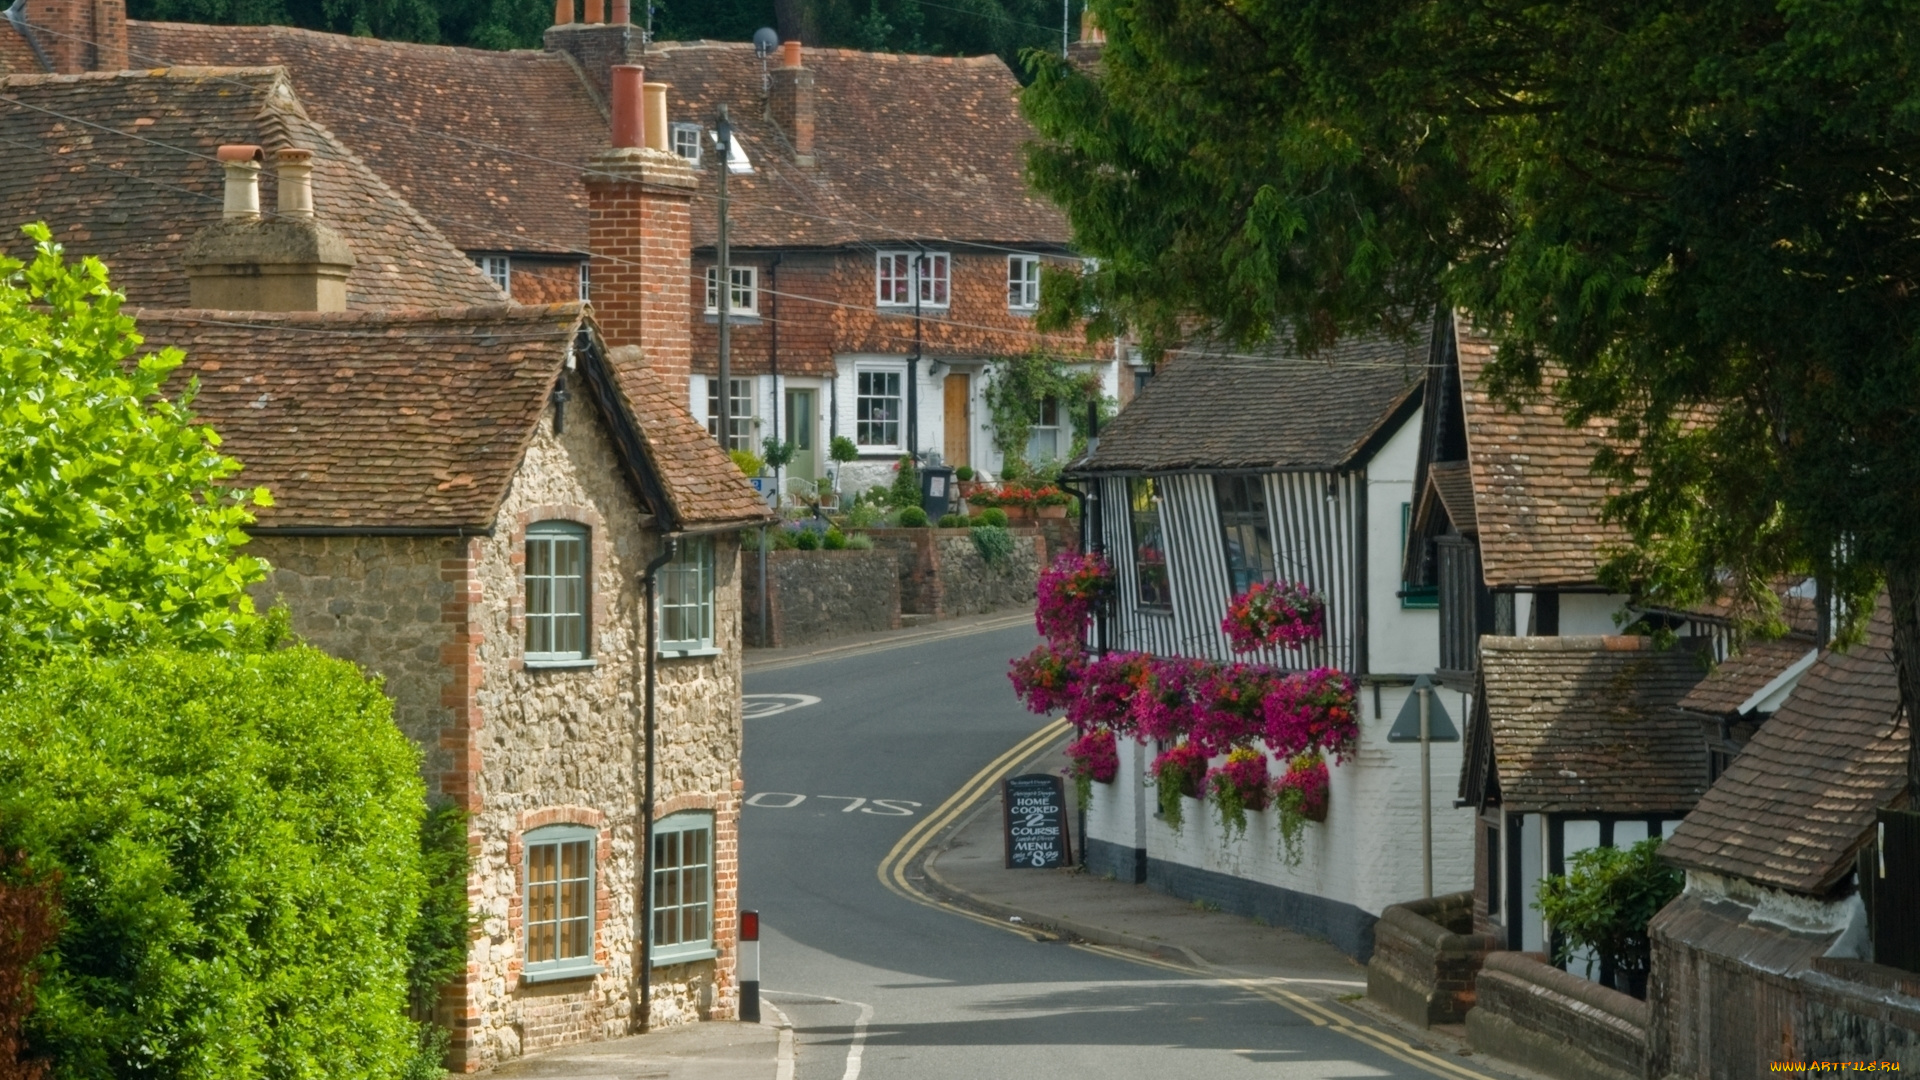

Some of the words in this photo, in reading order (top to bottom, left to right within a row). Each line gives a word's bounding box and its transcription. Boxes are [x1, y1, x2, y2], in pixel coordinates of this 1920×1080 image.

[745, 792, 922, 816] SLO
[1017, 798, 1050, 806] HOME
[1011, 806, 1059, 814] COOKED
[1025, 813, 1045, 827] 2
[1011, 826, 1060, 836] COURSE
[1014, 842, 1053, 851] MENU
